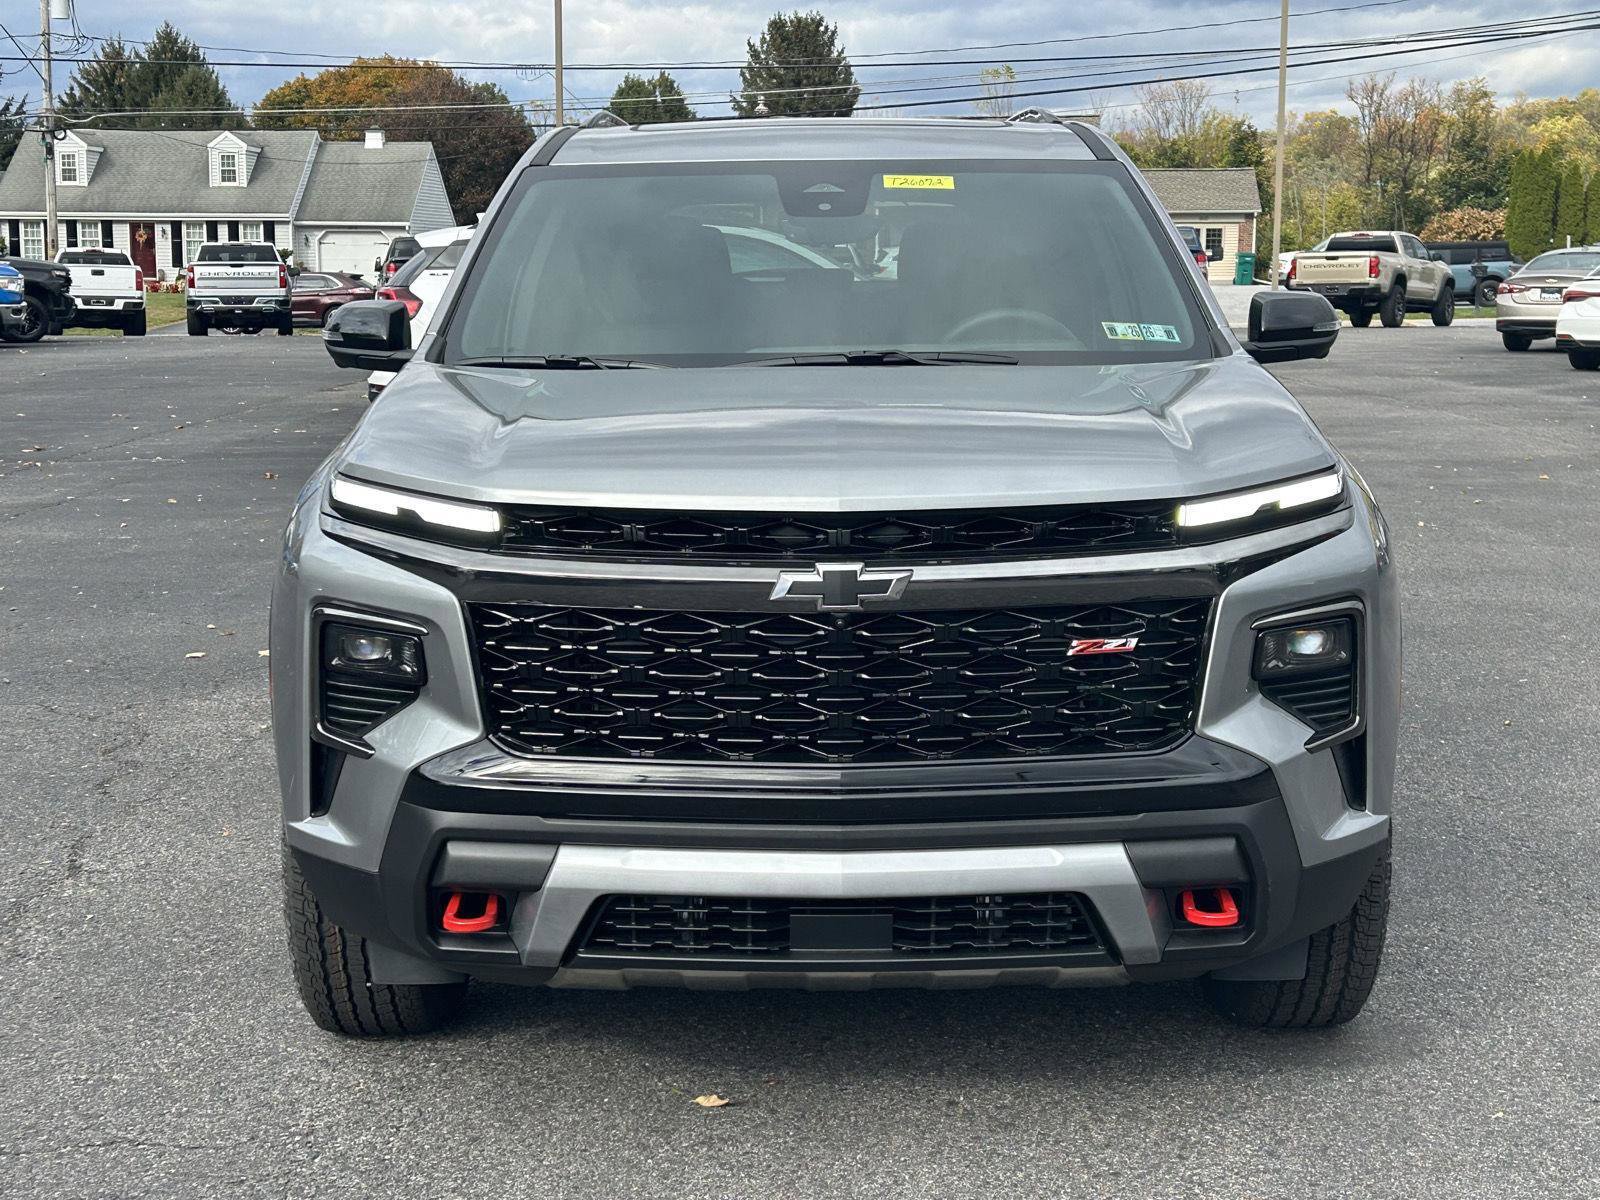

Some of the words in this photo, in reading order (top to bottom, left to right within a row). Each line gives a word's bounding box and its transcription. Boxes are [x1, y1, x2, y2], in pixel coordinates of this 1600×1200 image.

[1127, 325, 1141, 338] 26
[1142, 325, 1156, 338] 26
[1066, 637, 1139, 656] Z71
